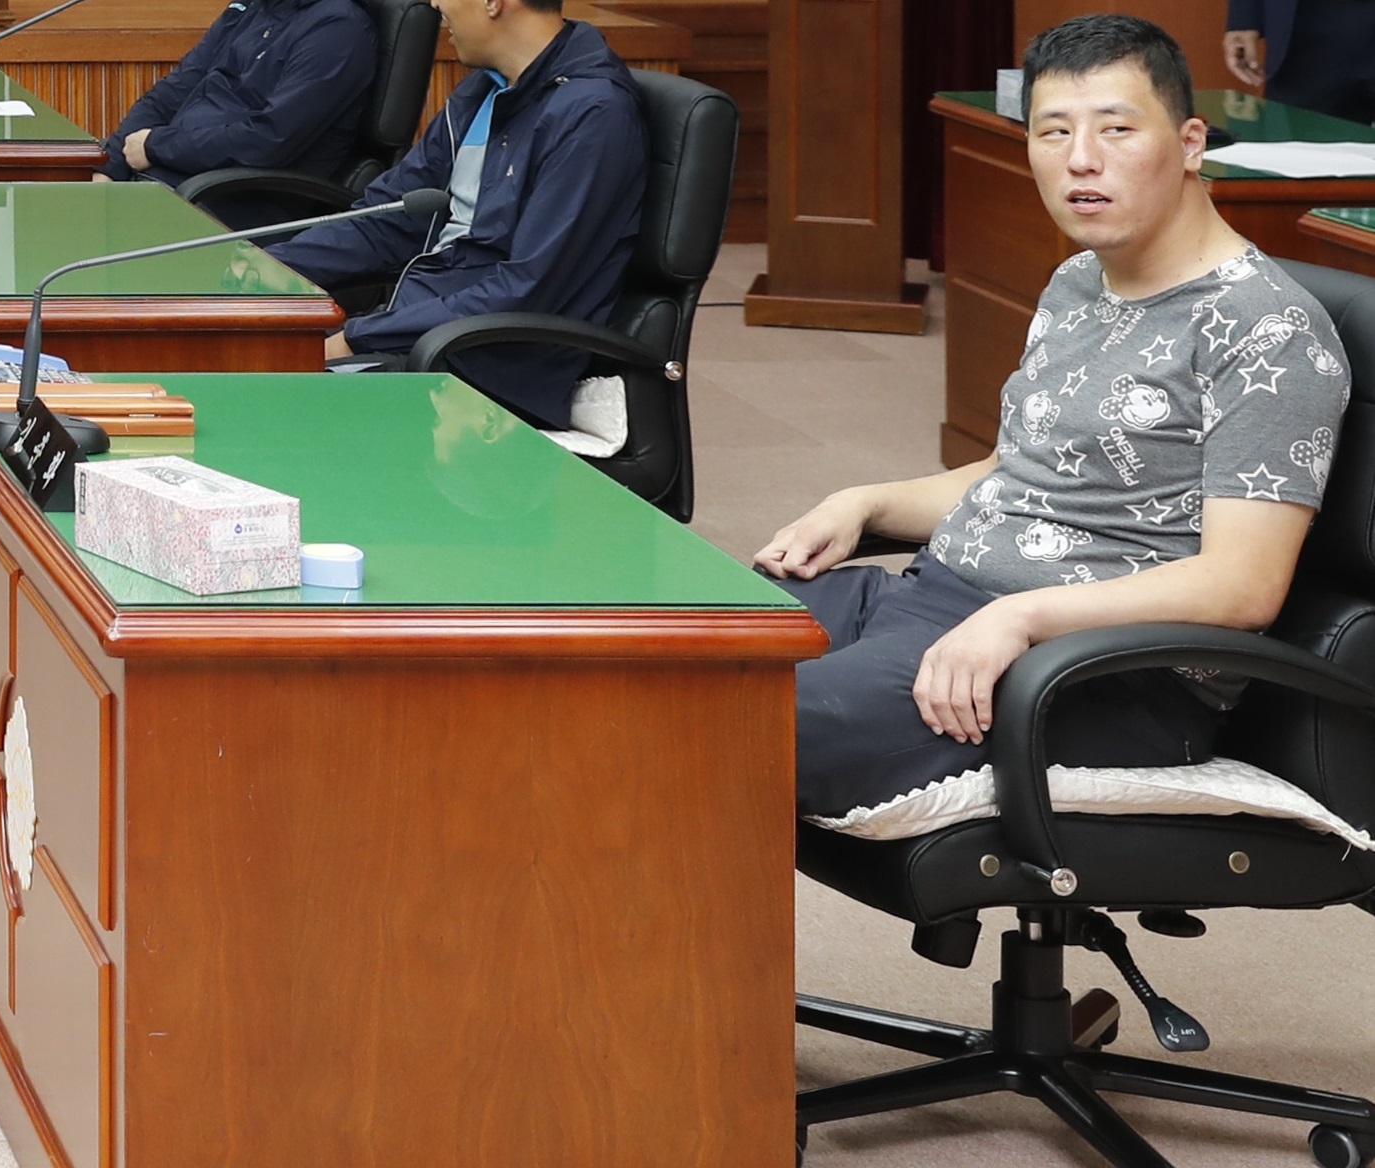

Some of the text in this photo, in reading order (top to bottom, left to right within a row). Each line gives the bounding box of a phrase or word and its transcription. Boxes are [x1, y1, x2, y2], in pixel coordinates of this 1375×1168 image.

[1241, 328, 1293, 360] TREND
[1096, 435, 1140, 487] PRETTY
[1110, 426, 1146, 473] TREND
